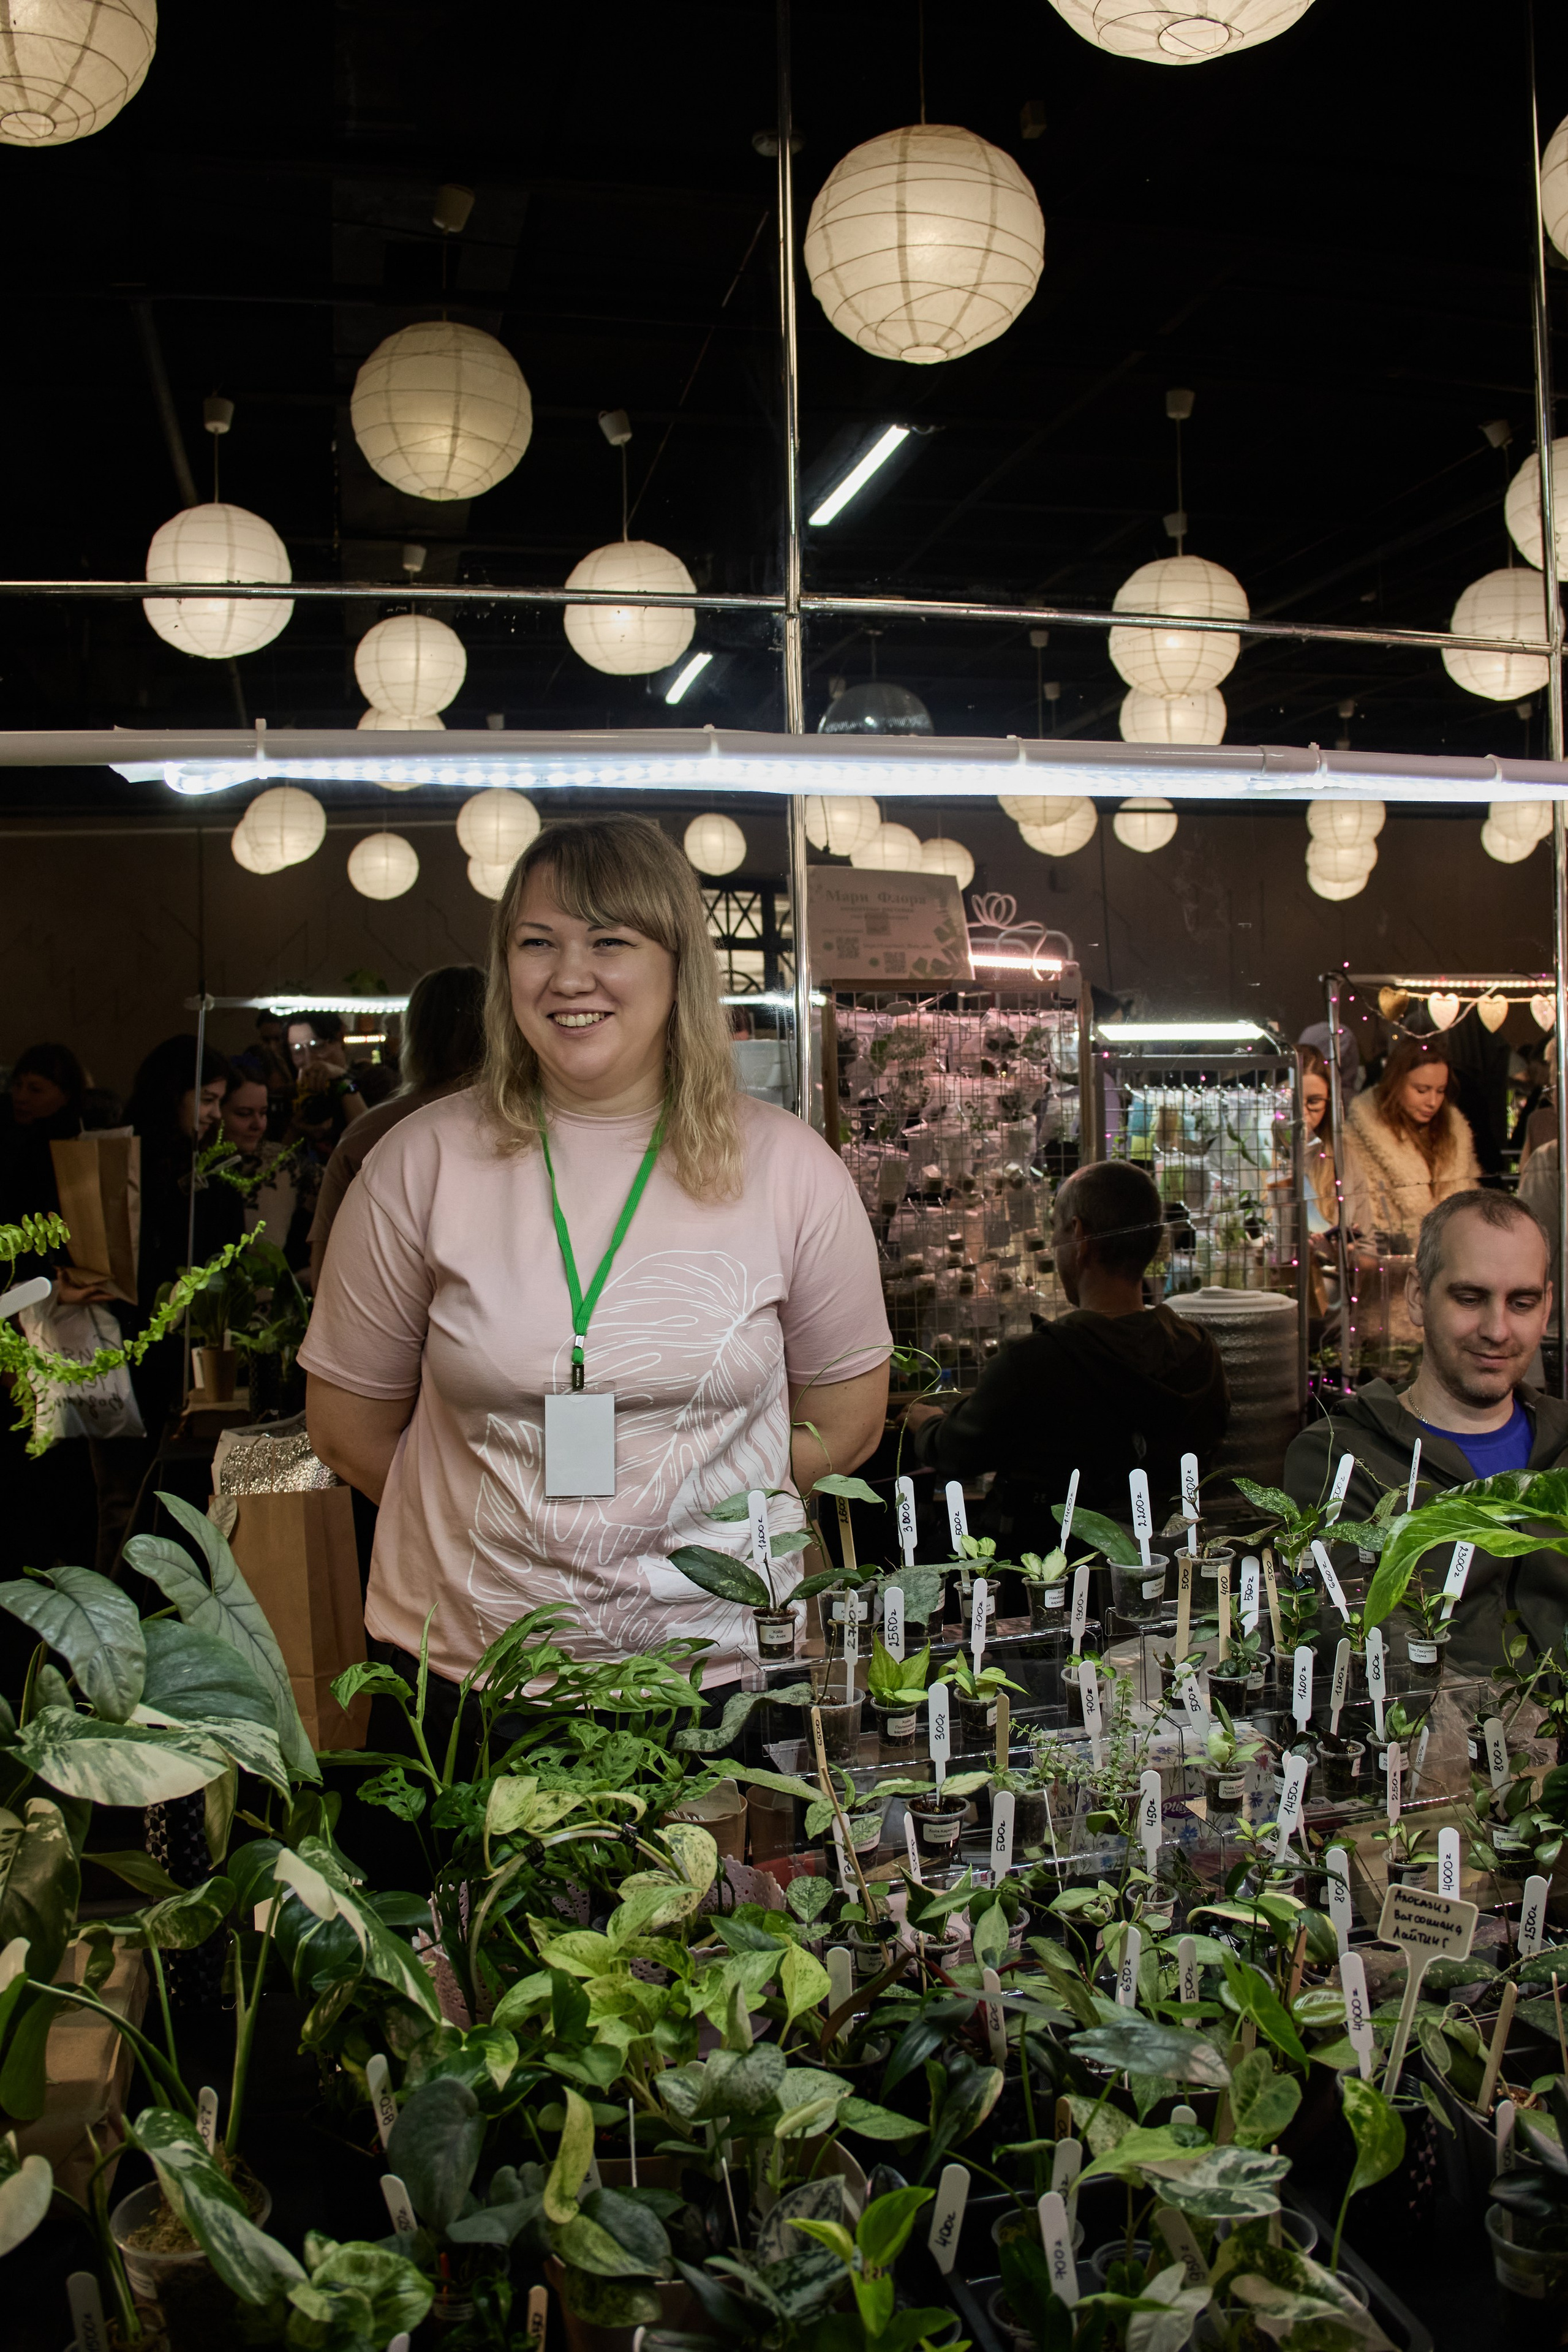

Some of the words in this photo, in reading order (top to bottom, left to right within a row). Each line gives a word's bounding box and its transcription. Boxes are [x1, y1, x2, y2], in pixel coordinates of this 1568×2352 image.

[826, 890, 869, 905] Мари
[877, 892, 927, 907] Флора
[1181, 1569, 1189, 1589] 500
[1220, 1576, 1229, 1596] 400
[1393, 1926, 1449, 1948] Лайтинг
